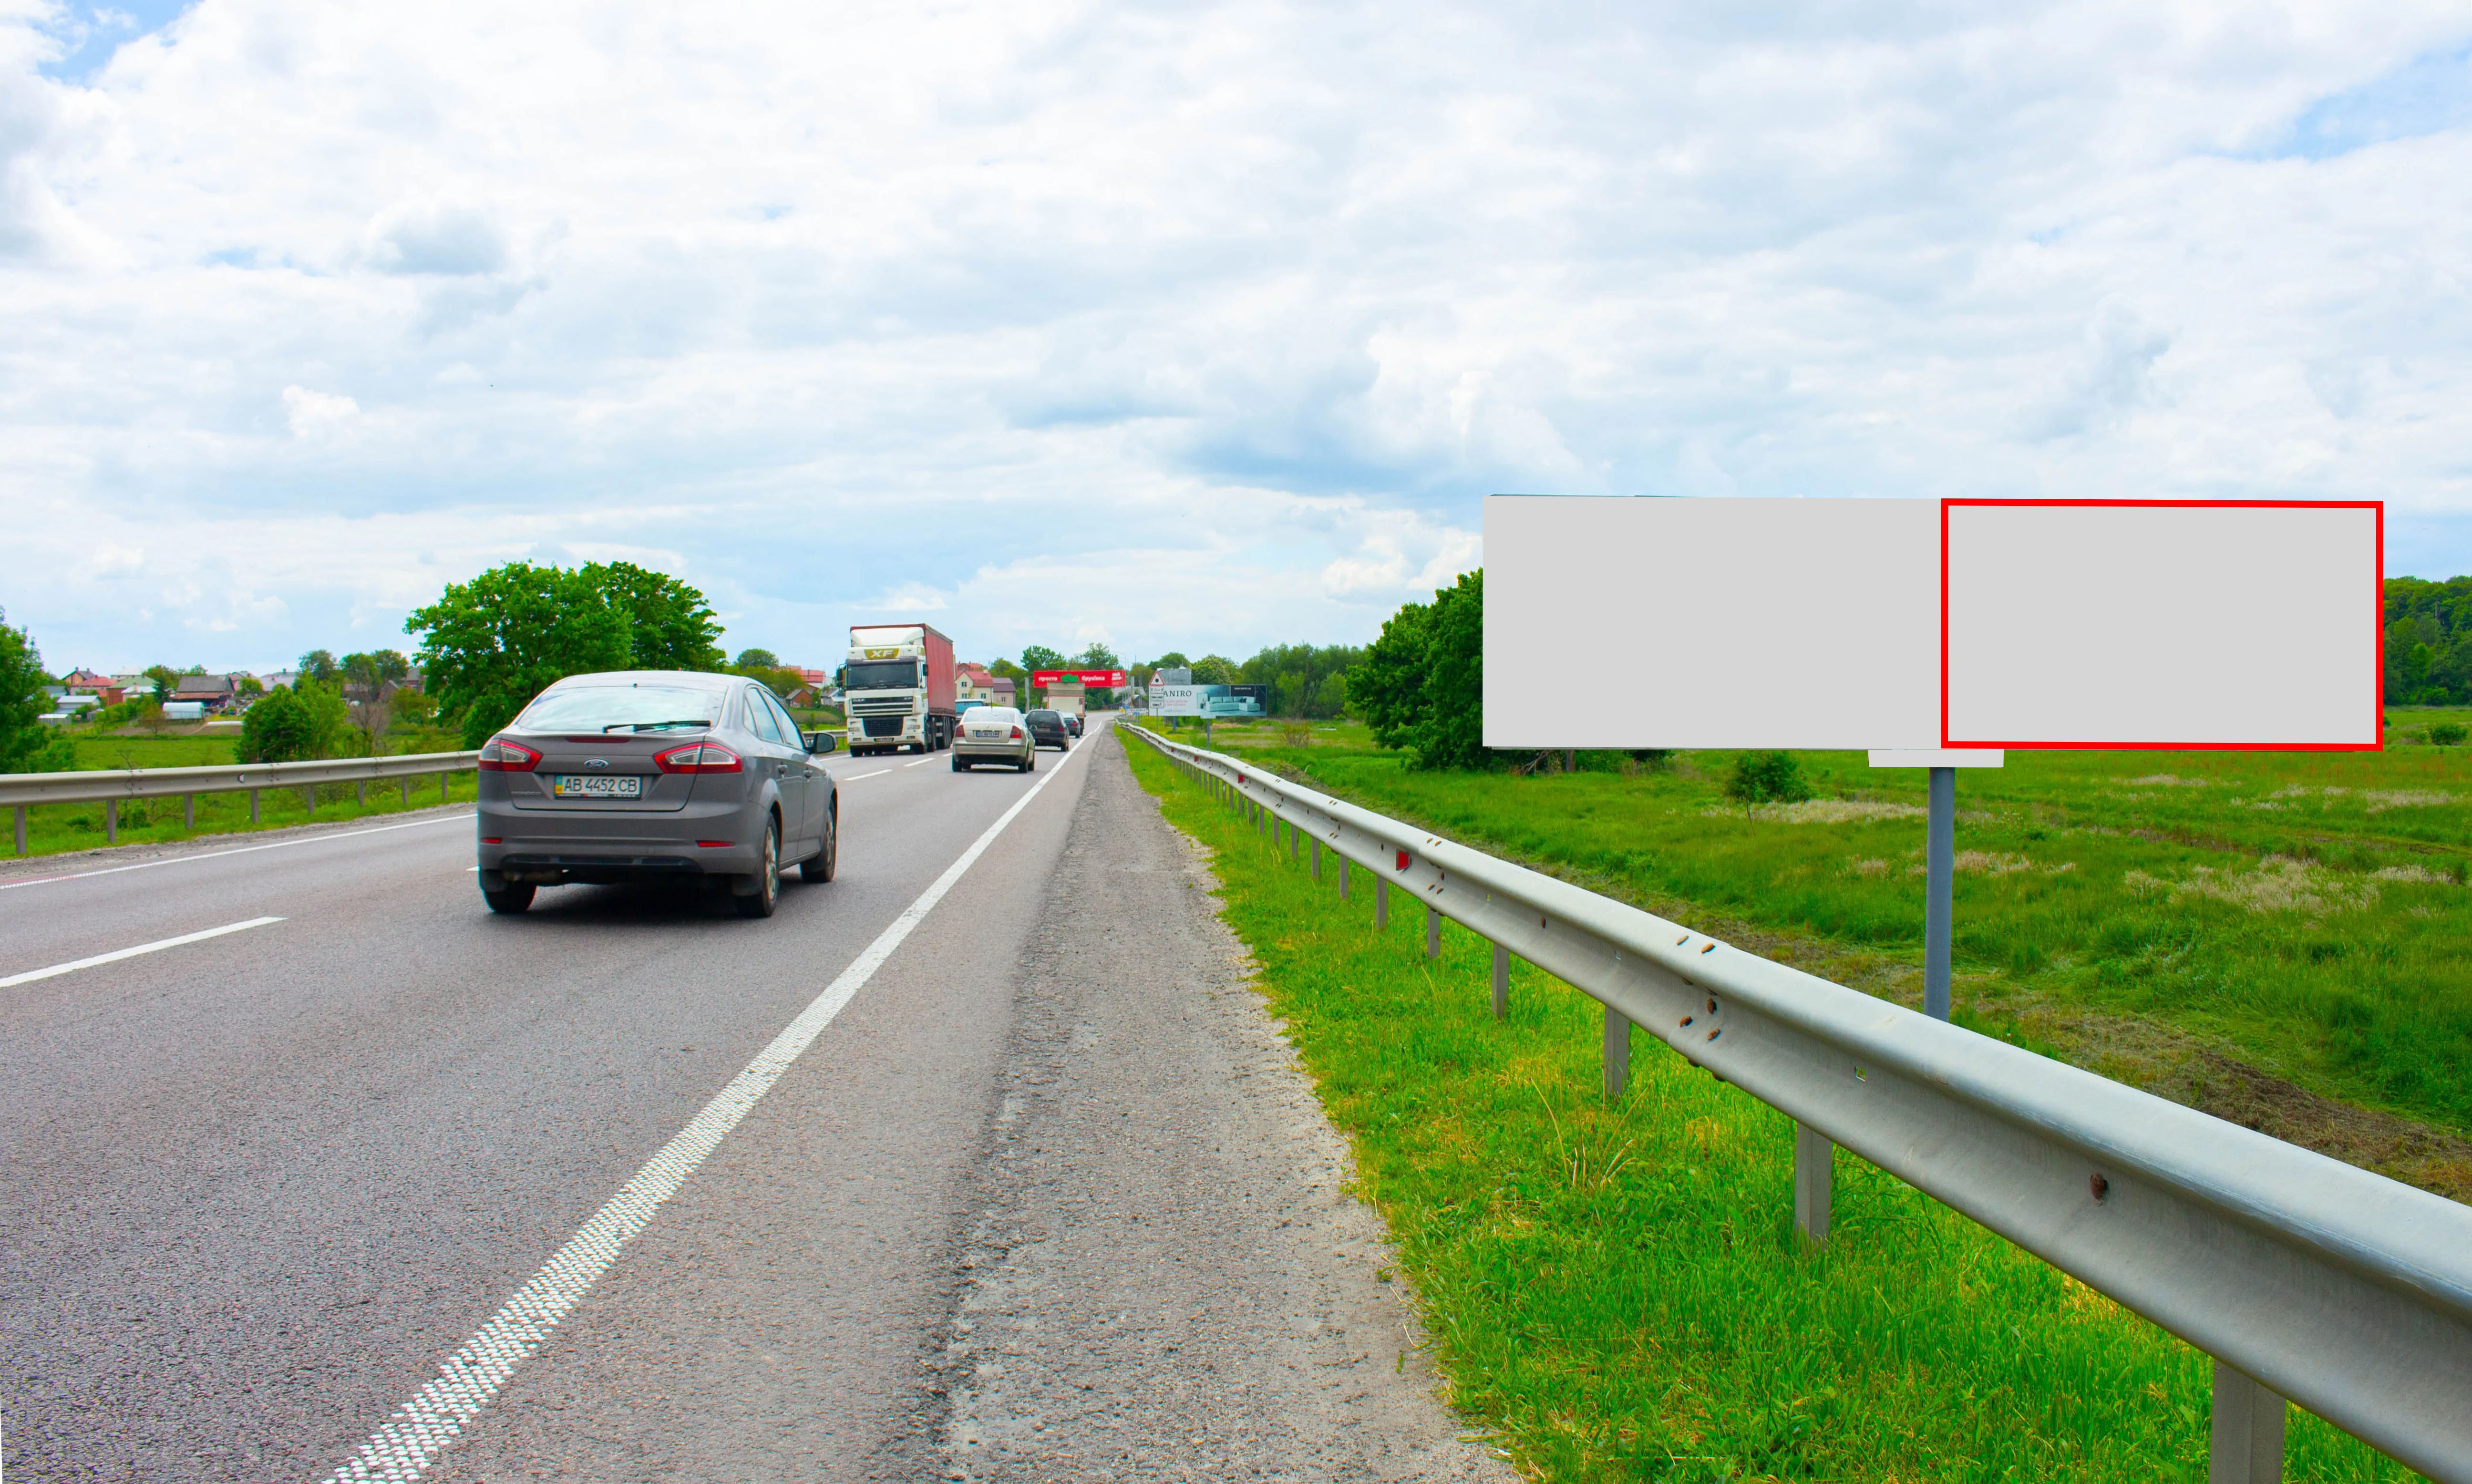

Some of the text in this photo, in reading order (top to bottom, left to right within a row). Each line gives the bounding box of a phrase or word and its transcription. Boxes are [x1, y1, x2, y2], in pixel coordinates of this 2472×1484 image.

[564, 778, 637, 792] AB 4452 CB
